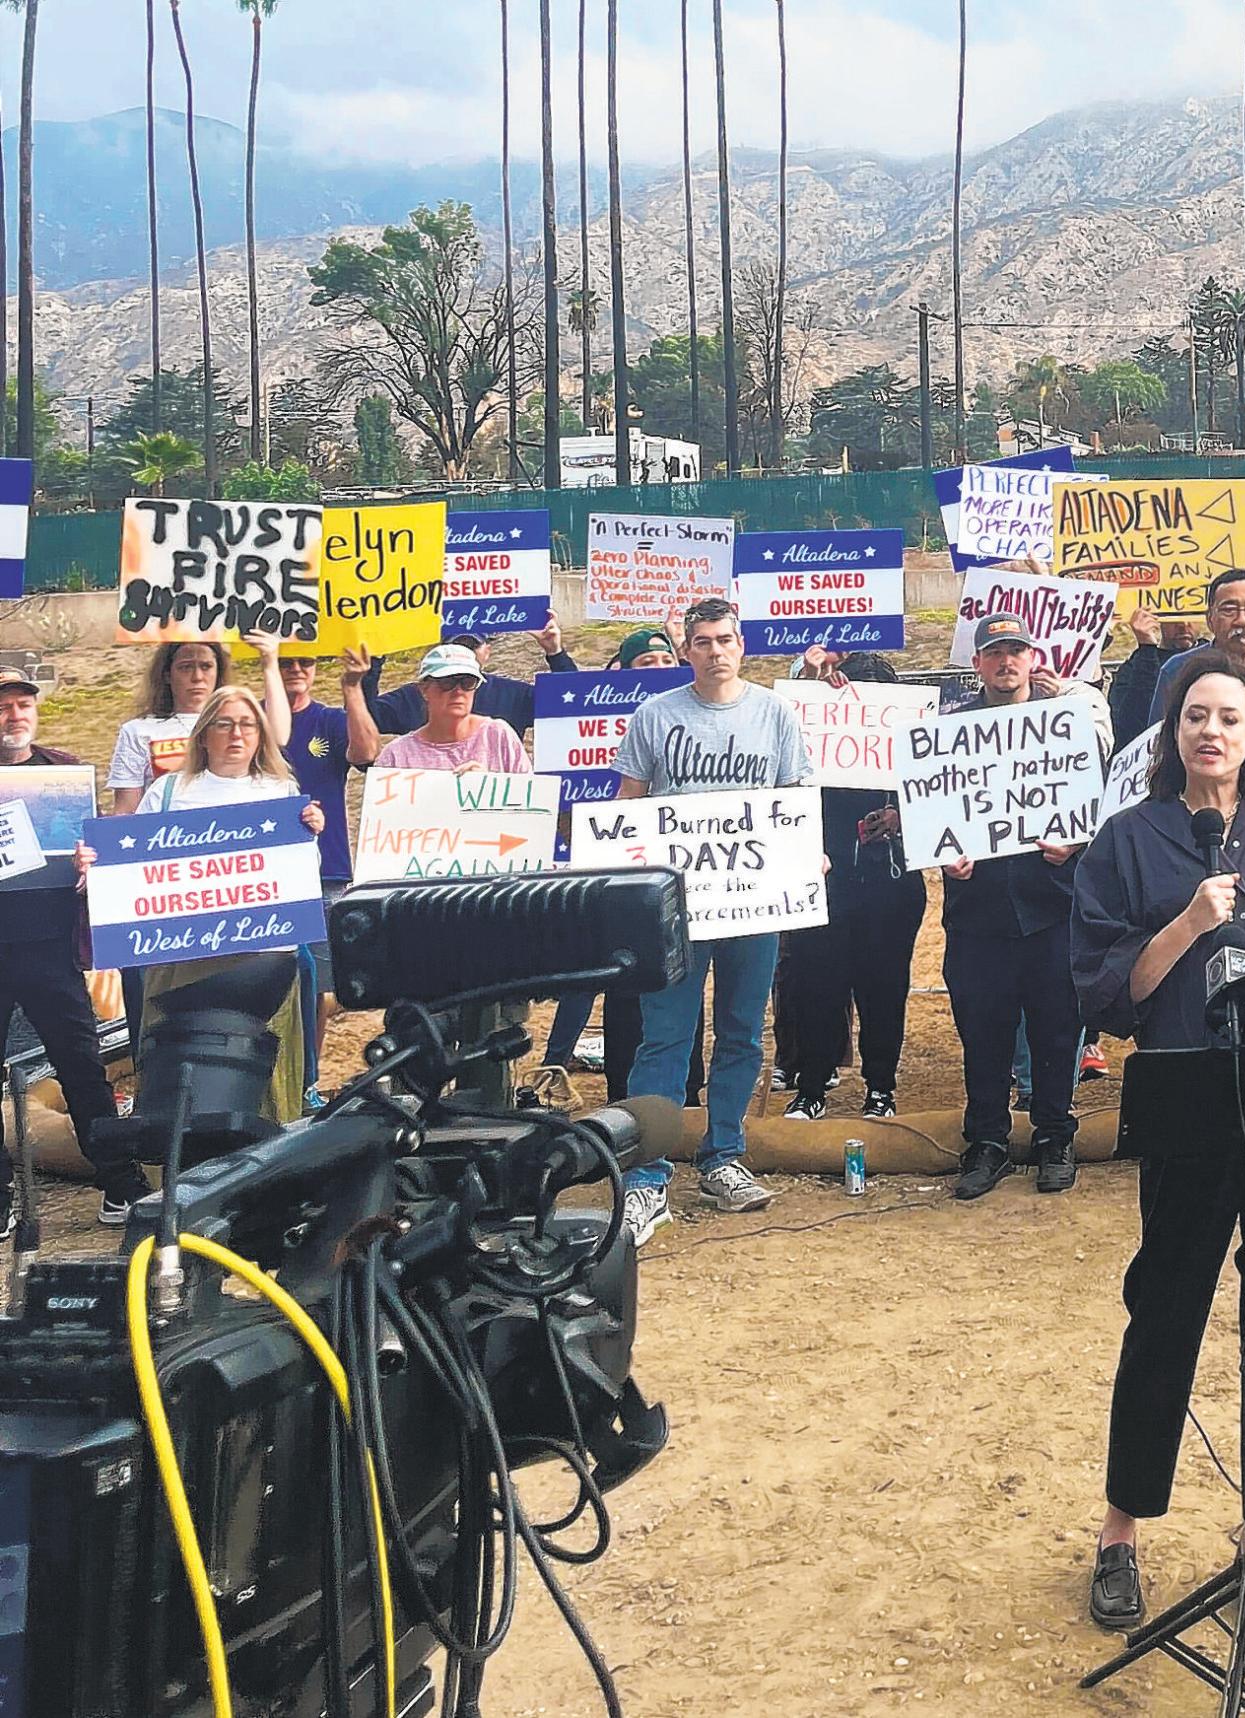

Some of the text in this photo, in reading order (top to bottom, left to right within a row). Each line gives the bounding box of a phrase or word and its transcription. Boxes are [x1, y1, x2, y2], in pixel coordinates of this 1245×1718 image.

[969, 467, 1053, 497] PERFECT
[964, 496, 1013, 516] MORE
[1059, 487, 1193, 537] ALTADENA
[136, 500, 322, 558] TRUST
[615, 521, 669, 537] Perfect
[325, 511, 414, 582] elyn
[782, 543, 862, 564] Altadena
[977, 536, 1052, 559] CHAO
[455, 554, 511, 571] SAVED
[1169, 563, 1200, 579] AN
[324, 568, 443, 618] lendon
[778, 573, 865, 591] WE SAVED
[1138, 585, 1210, 610] INVEST
[459, 605, 528, 632] of Lake
[770, 597, 873, 616] OURSELVES!
[764, 623, 881, 646] West of Lake
[578, 720, 607, 737] WE
[909, 710, 1075, 760] BLAMING
[665, 724, 769, 787] Altadena
[375, 772, 552, 812] IT WILL
[562, 779, 613, 800] West
[902, 763, 997, 803] mother
[1012, 750, 1091, 781] nature
[962, 782, 1069, 822] IS NOT
[147, 820, 257, 851] Altadena
[589, 800, 807, 840] We Burned for
[934, 798, 1100, 858] A PLAN!
[361, 818, 462, 854] HAPPEN
[143, 852, 266, 885] WE SAVED
[625, 840, 767, 872] 3 DAYS
[134, 881, 279, 916] OURSELVES!
[725, 878, 760, 892] the
[128, 913, 294, 957] West of Lake
[47, 1297, 98, 1309] SONY
